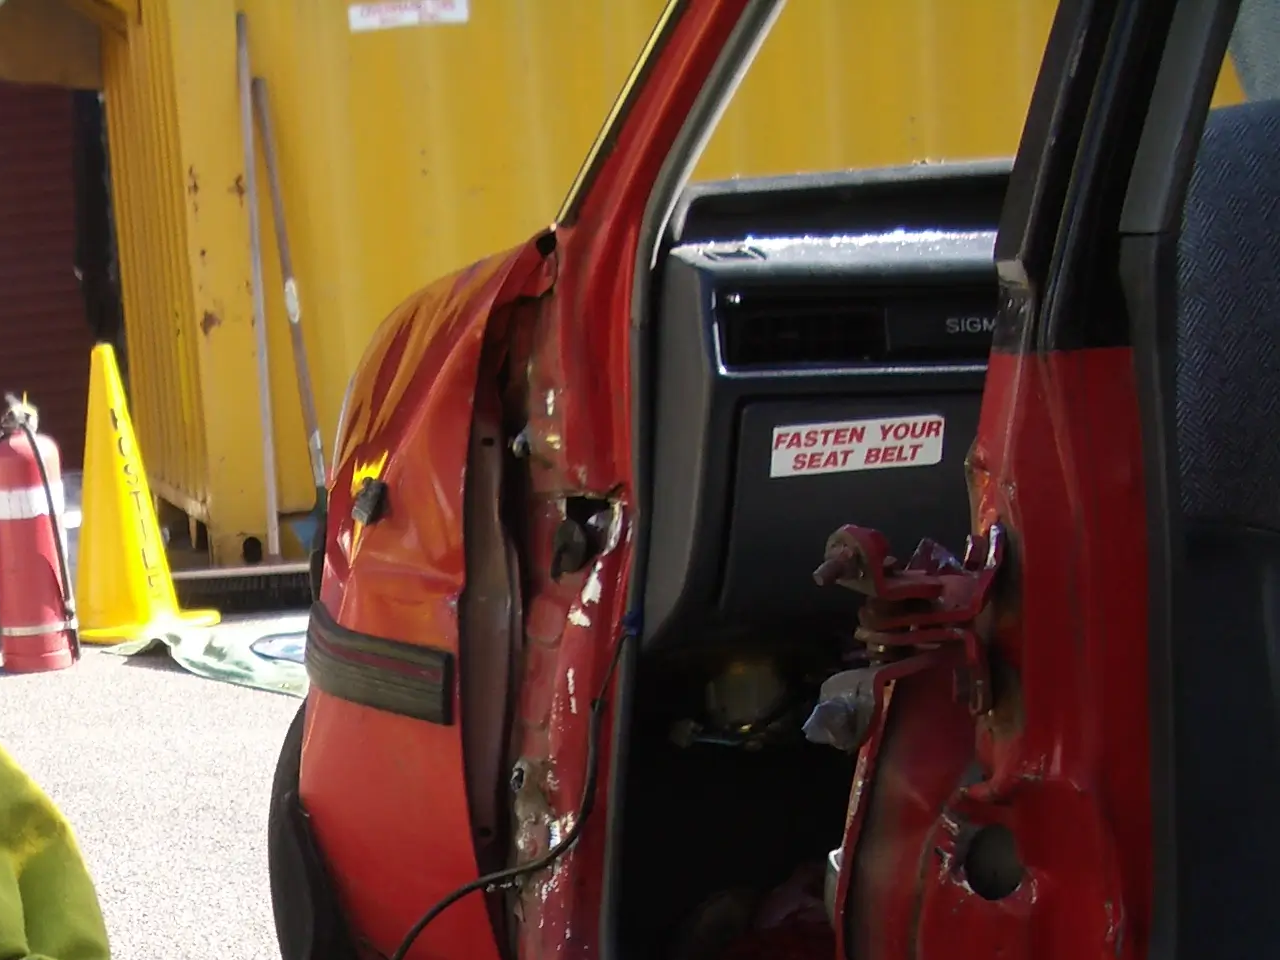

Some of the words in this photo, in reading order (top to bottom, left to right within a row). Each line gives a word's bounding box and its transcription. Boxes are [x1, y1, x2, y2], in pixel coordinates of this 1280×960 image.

[774, 426, 866, 450] FASTEN
[880, 420, 942, 442] YOUR
[792, 449, 855, 471] SEAT
[864, 444, 923, 465] BELT
